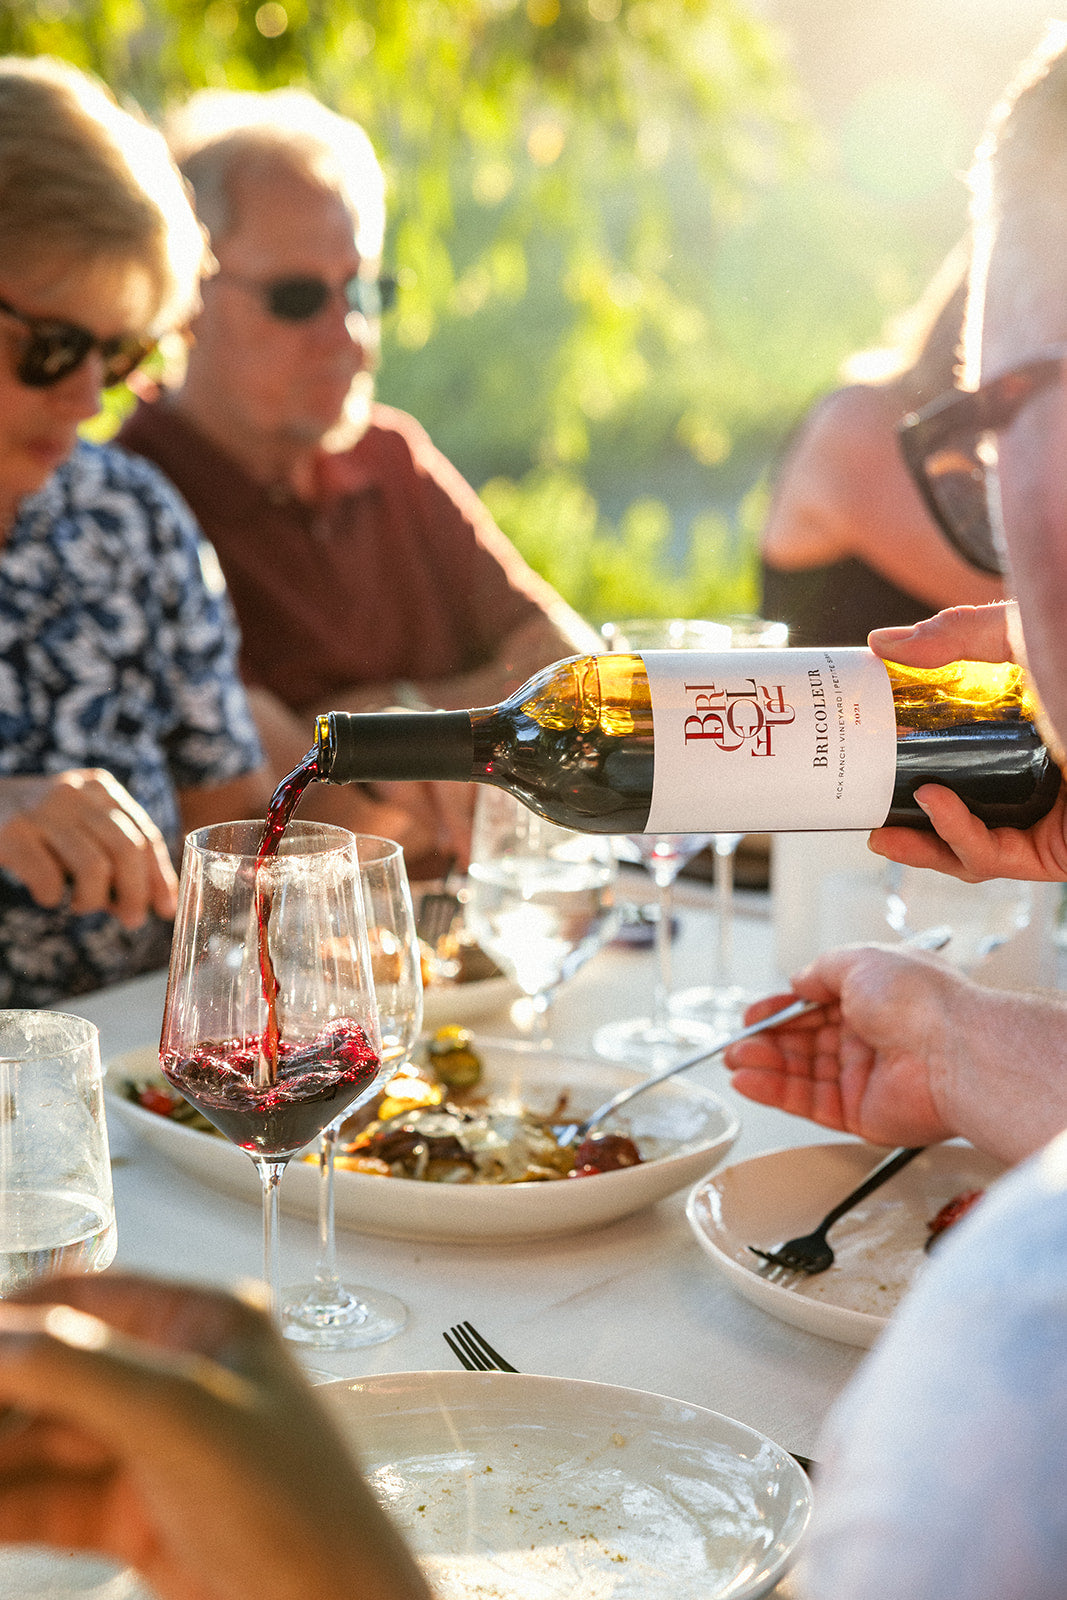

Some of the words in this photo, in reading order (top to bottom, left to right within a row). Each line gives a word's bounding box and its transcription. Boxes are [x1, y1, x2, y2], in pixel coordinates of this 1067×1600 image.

[836, 696, 846, 742] VINEYARD
[838, 746, 846, 778] RANCH
[836, 781, 844, 800] KICK
